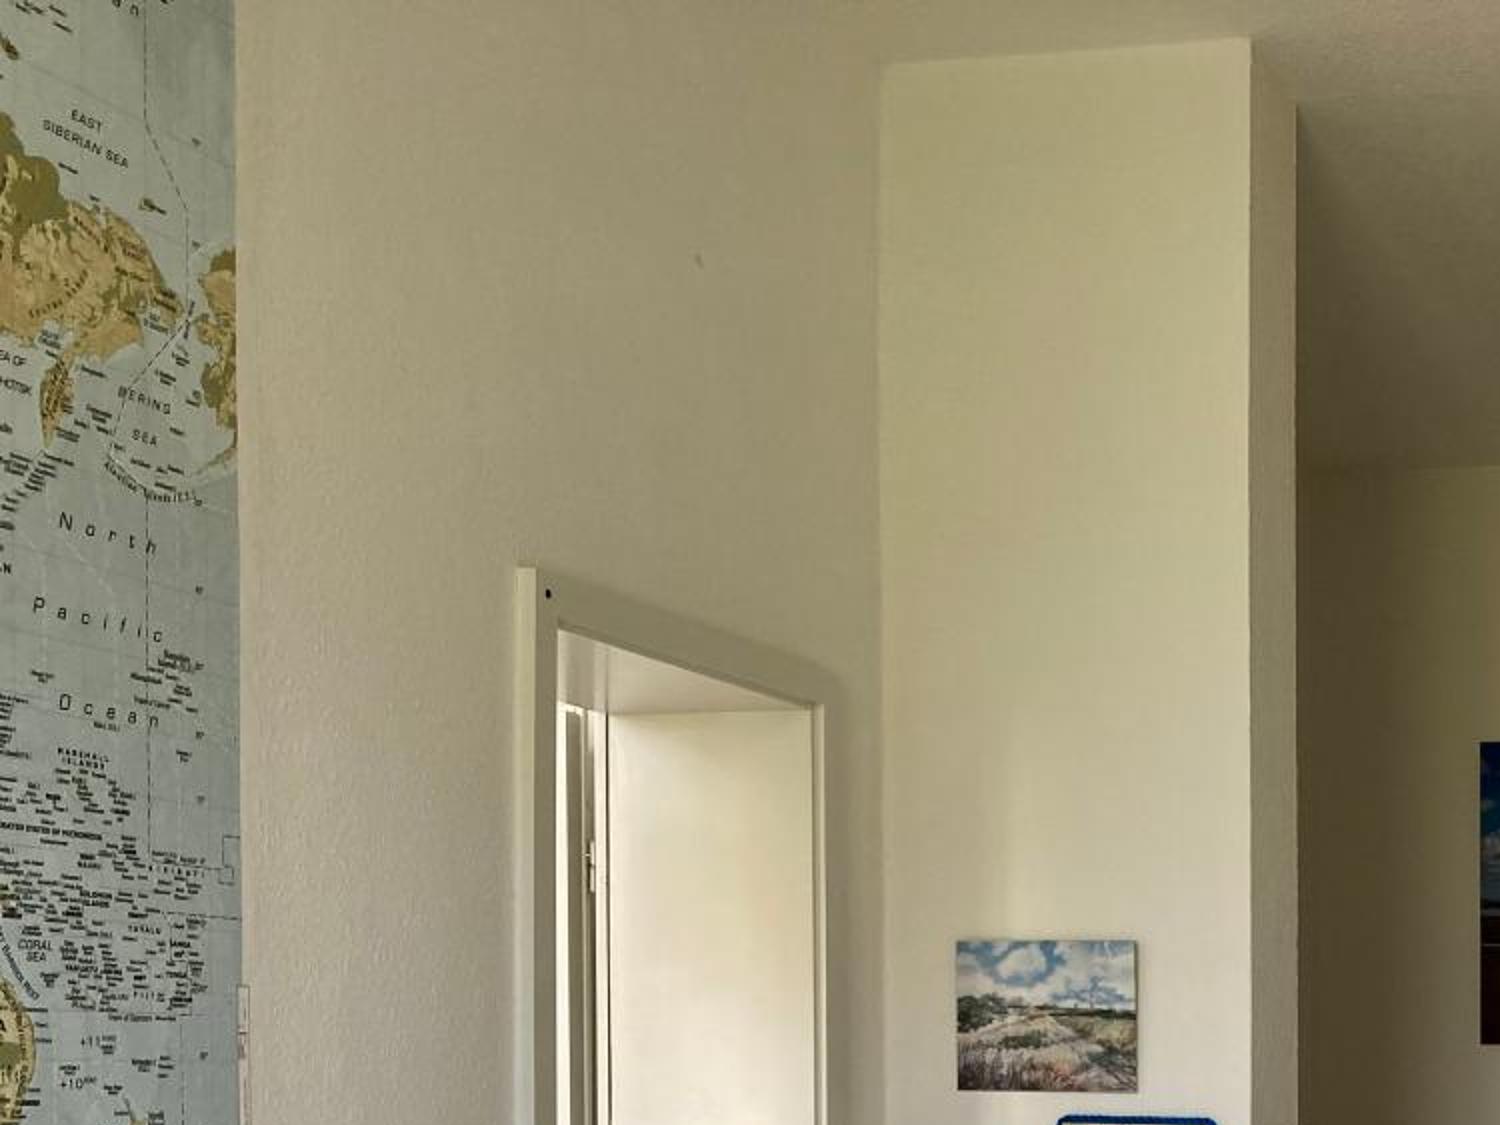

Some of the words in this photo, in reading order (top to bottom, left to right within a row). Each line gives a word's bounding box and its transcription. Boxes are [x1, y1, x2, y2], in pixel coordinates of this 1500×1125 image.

[70, 109, 103, 132] EAST
[42, 119, 102, 156] SIBERIAN
[105, 149, 130, 169] SEA
[131, 429, 158, 447] SEA
[58, 511, 157, 555] North
[32, 596, 163, 643] Pacific
[58, 693, 159, 728] Ocean
